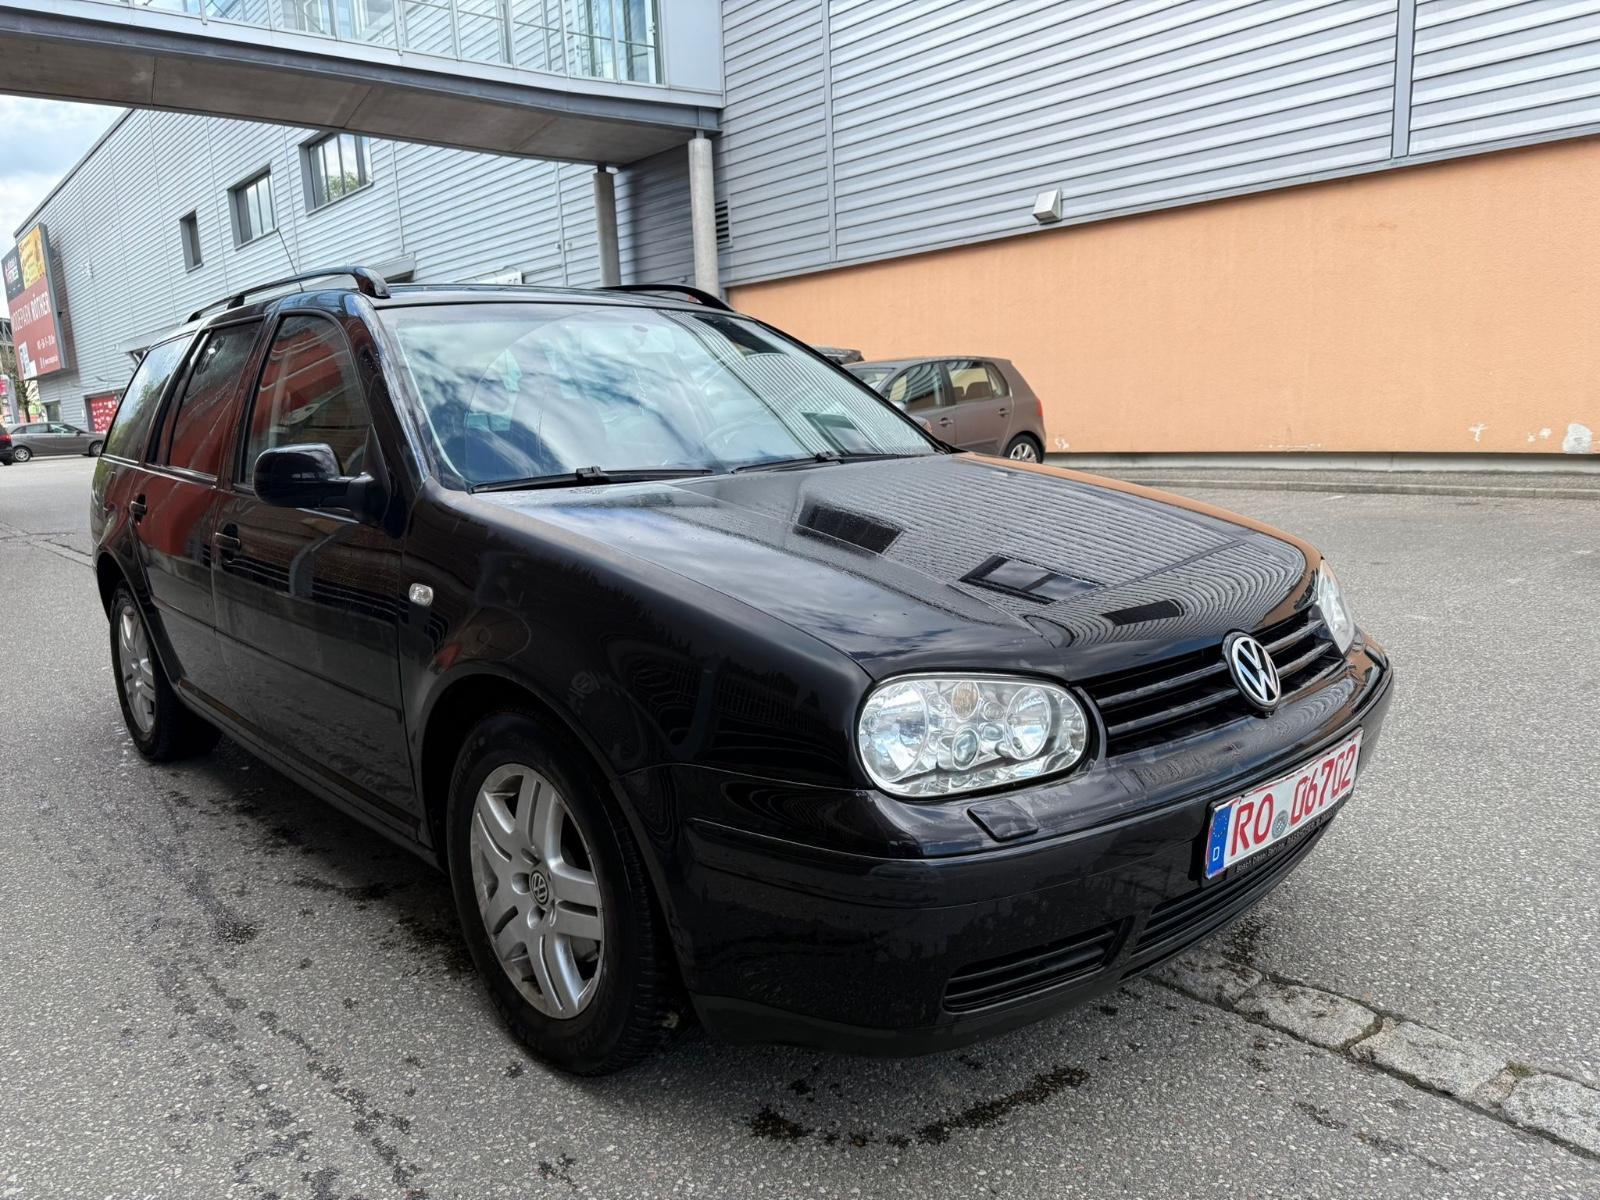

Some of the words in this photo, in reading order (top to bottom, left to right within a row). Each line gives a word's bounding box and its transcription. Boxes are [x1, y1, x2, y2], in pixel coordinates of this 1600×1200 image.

[1231, 792, 1274, 856] RO
[1290, 744, 1357, 826] 06702
[1212, 846, 1220, 861] D
